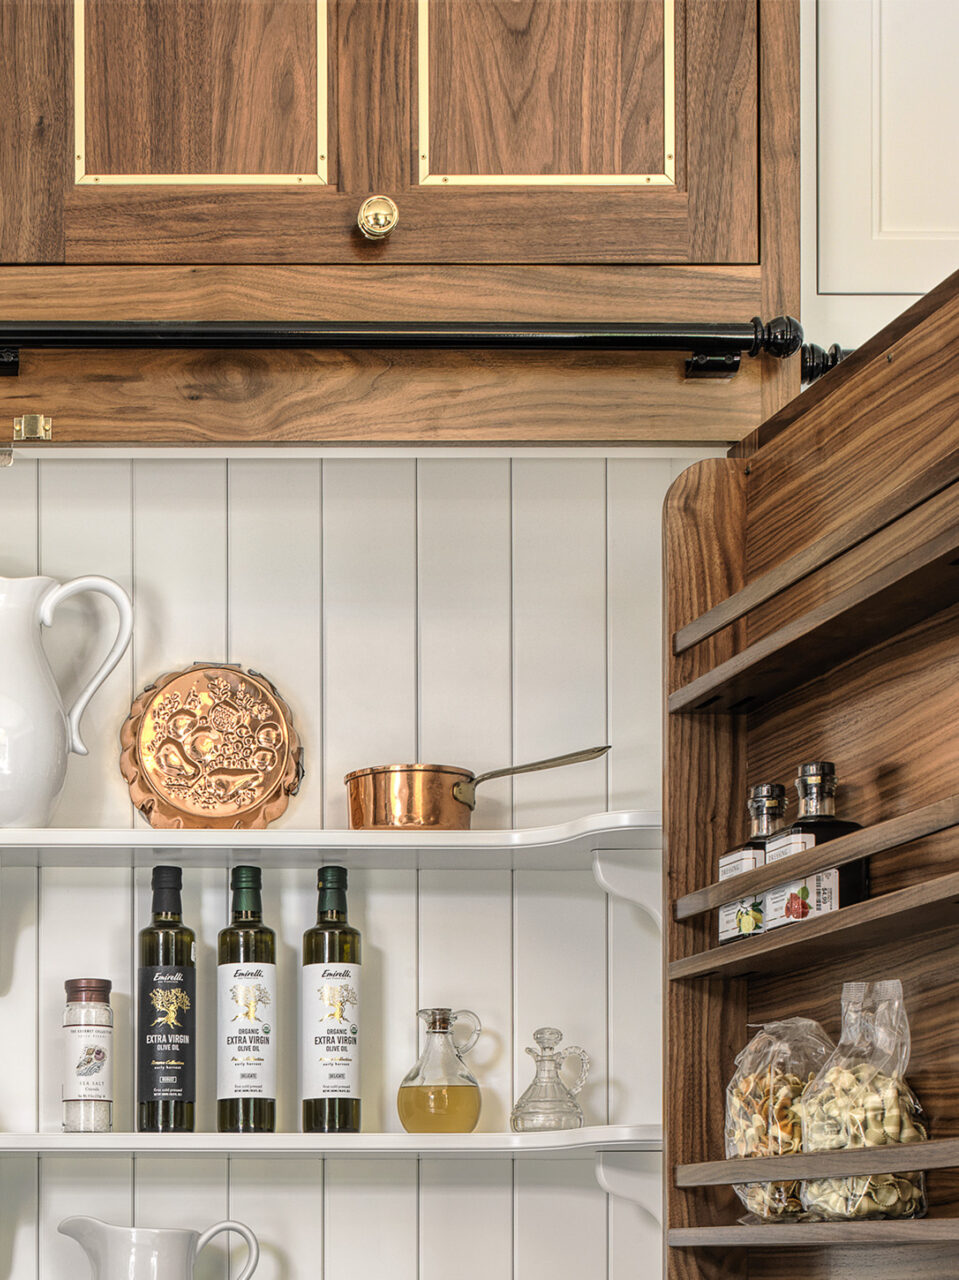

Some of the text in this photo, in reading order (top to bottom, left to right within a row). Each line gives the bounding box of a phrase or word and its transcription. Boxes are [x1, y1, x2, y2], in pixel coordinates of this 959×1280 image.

[146, 1035, 189, 1044] EXTRA VIRGIN
[227, 1036, 270, 1045] EXTRA VIRGIN
[315, 1036, 357, 1045] EXTRA VIRGIN
